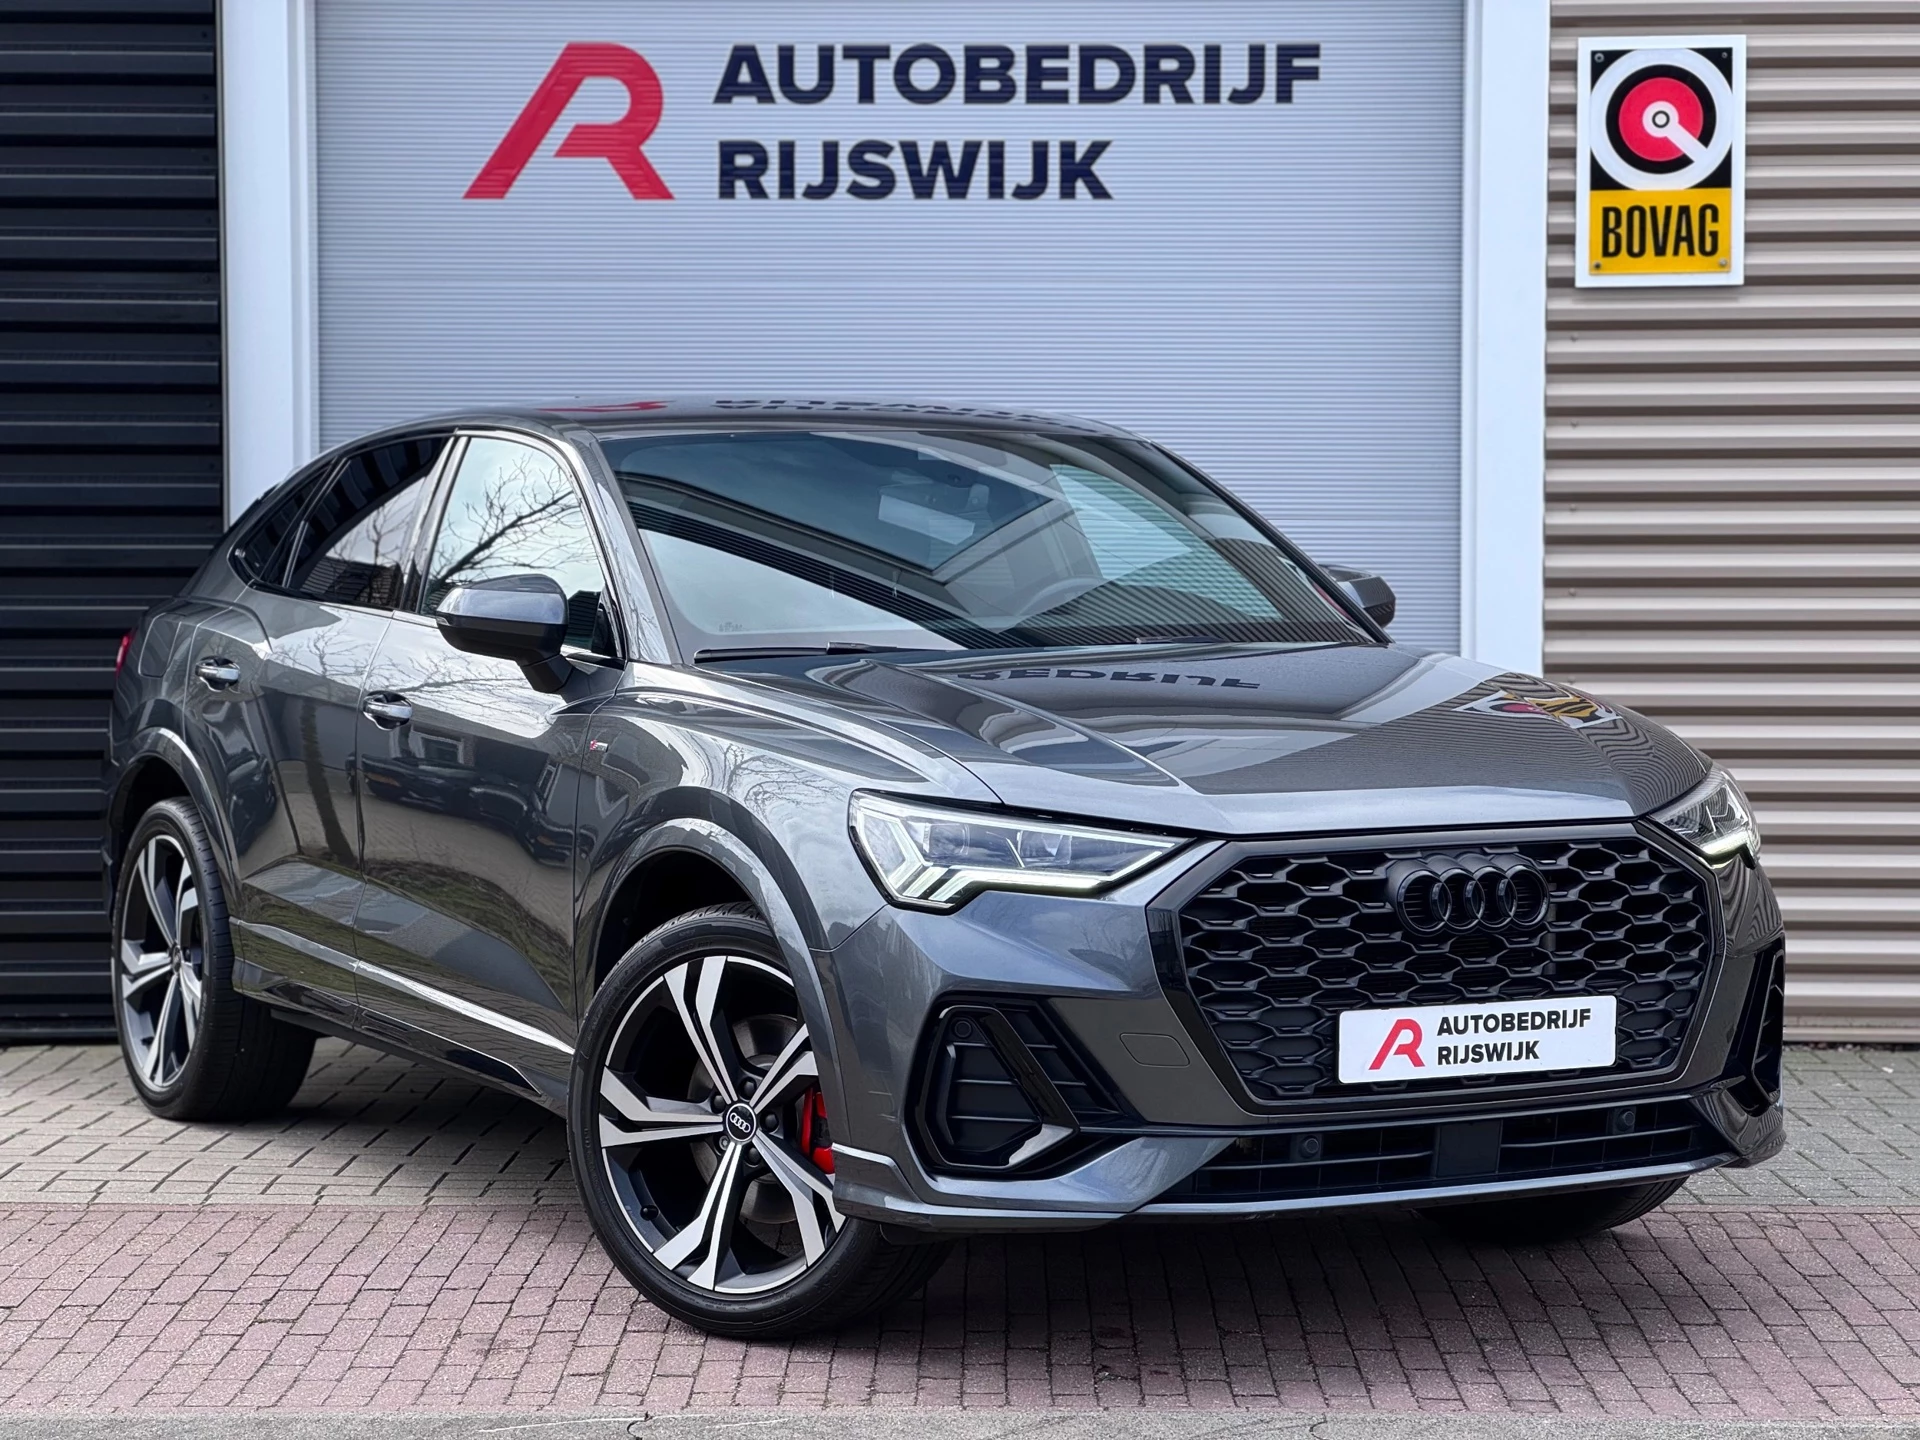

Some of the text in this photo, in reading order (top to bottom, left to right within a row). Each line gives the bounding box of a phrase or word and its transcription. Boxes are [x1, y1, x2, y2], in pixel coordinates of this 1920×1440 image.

[713, 43, 1321, 105] AUTOBEDRIJF
[718, 139, 1114, 201] RIJSWIJK
[1602, 203, 1719, 258] BOVAG
[1437, 1008, 1592, 1037] AUTOBEDRIJF
[1437, 1041, 1540, 1066] RIJSWIJK
